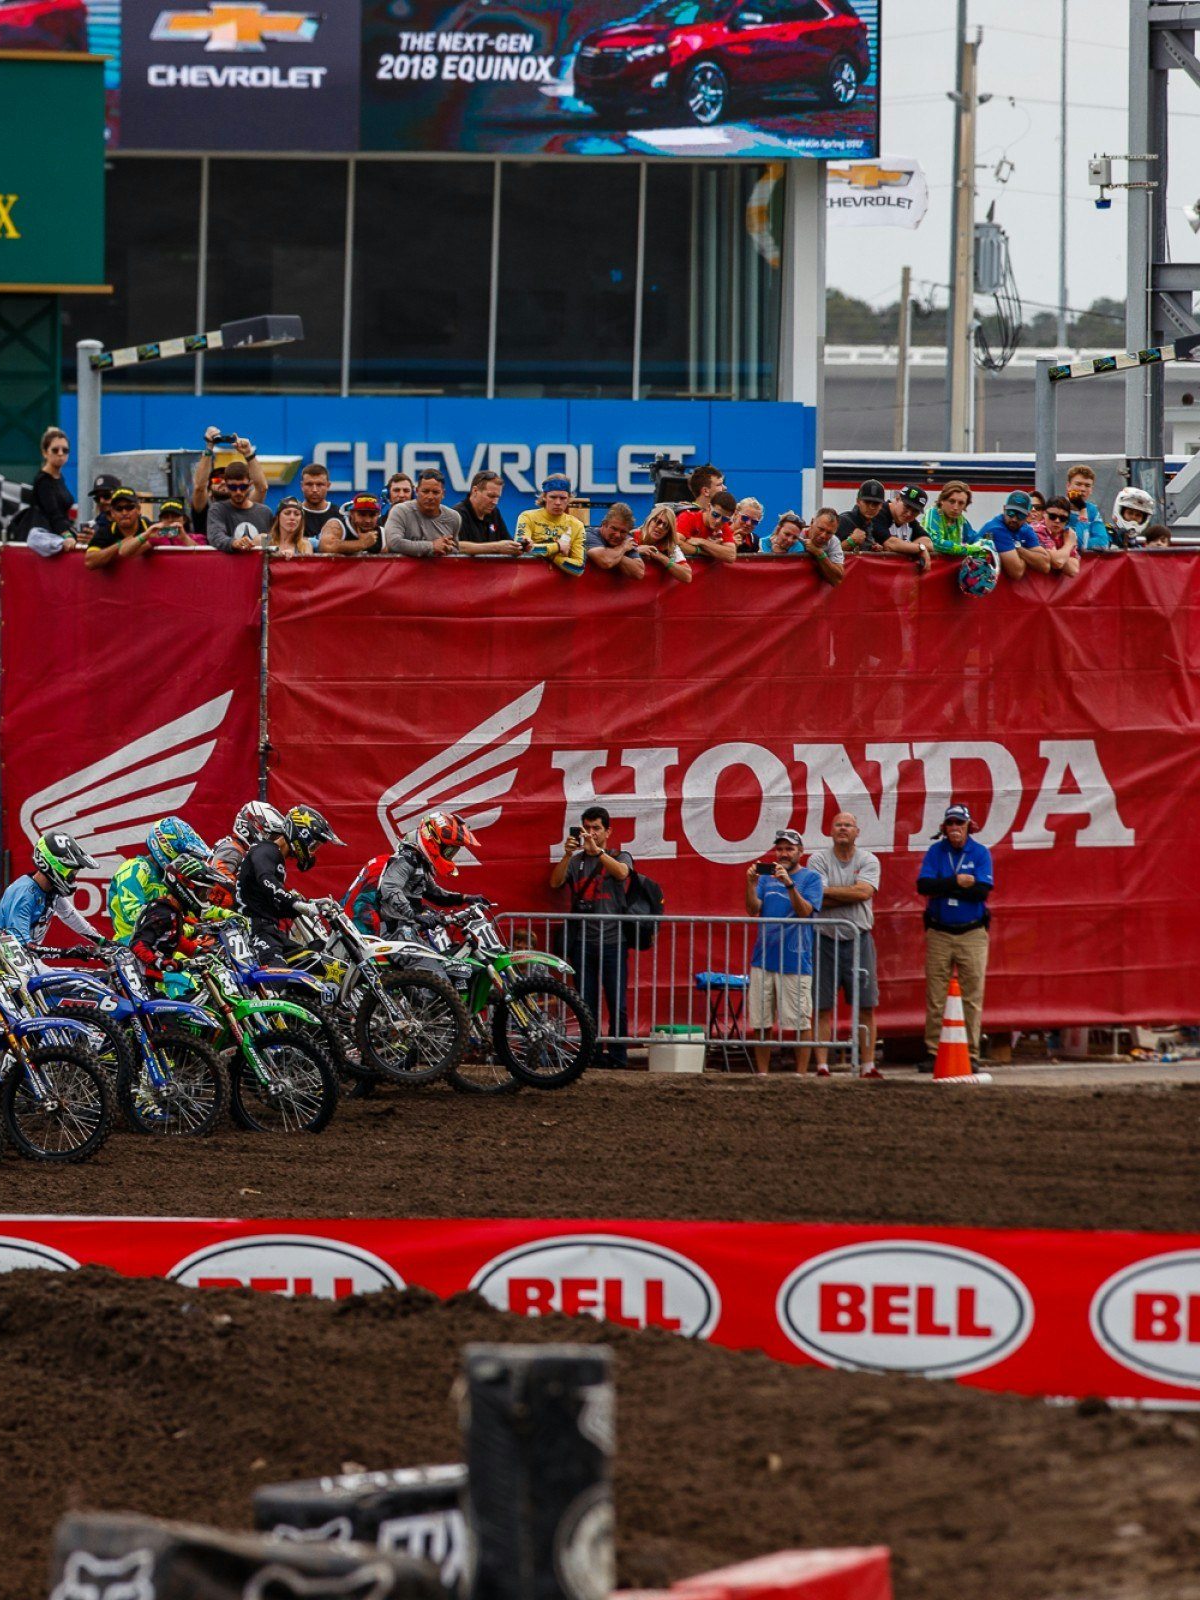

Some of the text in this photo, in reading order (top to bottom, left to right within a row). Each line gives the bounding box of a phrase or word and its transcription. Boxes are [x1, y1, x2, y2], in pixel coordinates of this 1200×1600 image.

[400, 32, 534, 53] THE NEXT-GEN
[148, 66, 327, 88] CHEVROLET
[377, 54, 556, 83] 2018 EQUINOX
[826, 195, 913, 210] HEVROLET
[549, 739, 1136, 865] HONDA
[249, 1047, 271, 1081] DUNLOP
[507, 1277, 684, 1332] BELL
[818, 1282, 994, 1338] BELL
